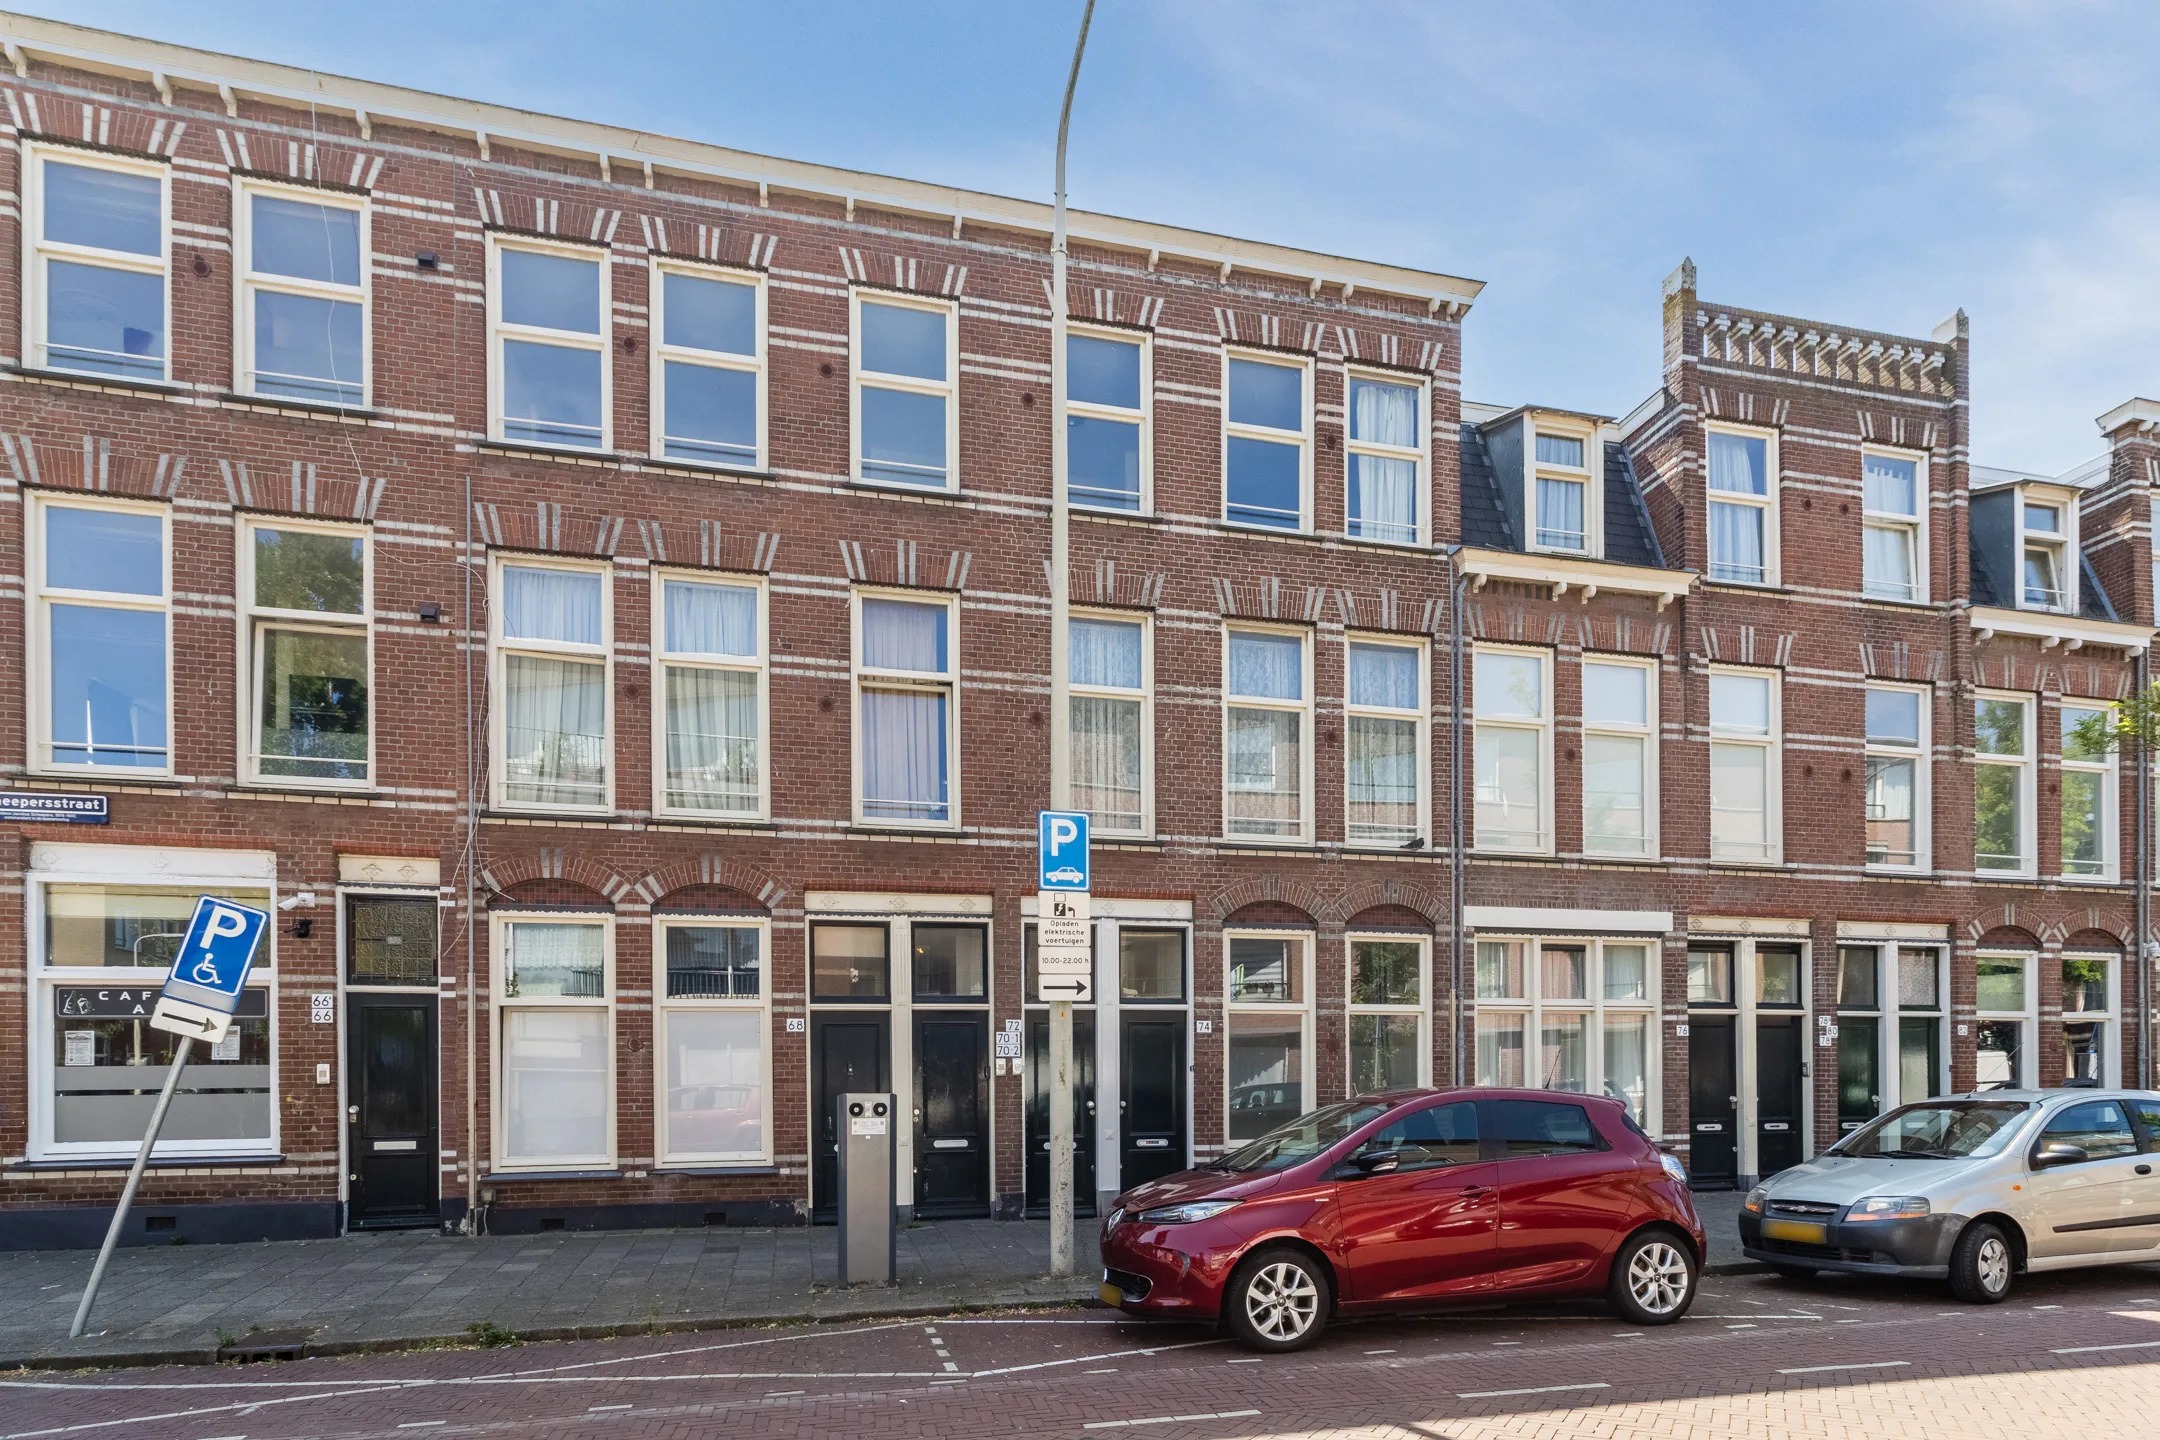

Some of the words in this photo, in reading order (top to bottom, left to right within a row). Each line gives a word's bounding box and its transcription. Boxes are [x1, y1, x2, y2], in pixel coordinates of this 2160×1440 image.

[1051, 818, 1078, 857] P
[199, 905, 247, 949] P
[1050, 919, 1079, 928] Opladen
[1044, 928, 1085, 936] elektrische
[1045, 937, 1085, 946] voertuigen
[98, 991, 152, 1001] CAF
[132, 1004, 145, 1014] A
[313, 1010, 331, 1021] 66
[788, 1020, 803, 1030] 68
[1007, 1020, 1020, 1031] 72
[1198, 1021, 1210, 1031] 74
[1677, 1026, 1688, 1035] 76
[1827, 1026, 1838, 1035] 80
[1820, 1036, 1831, 1045] 78
